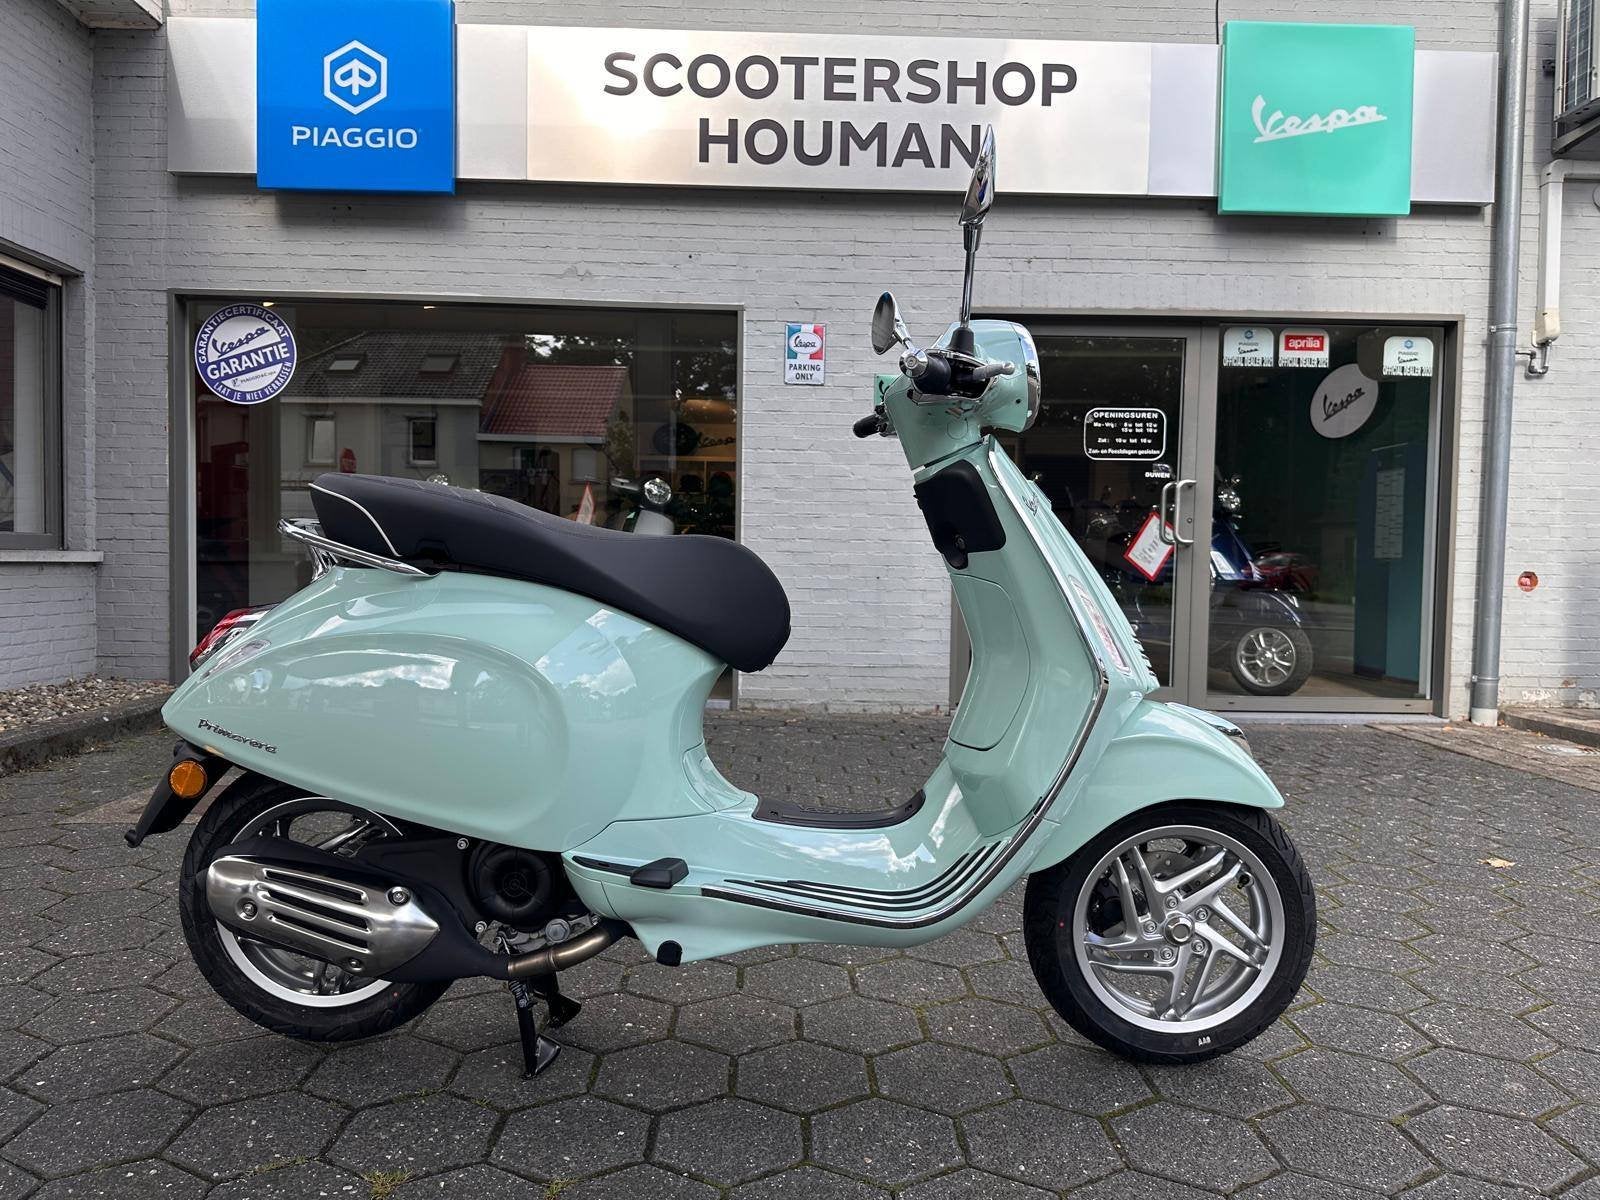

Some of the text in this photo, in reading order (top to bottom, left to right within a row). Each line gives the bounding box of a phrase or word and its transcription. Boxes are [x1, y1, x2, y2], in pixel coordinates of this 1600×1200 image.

[603, 51, 1077, 107] SCOOTERSHOP
[292, 125, 418, 149] PIAGGIO
[1252, 95, 1387, 143] Vespa
[699, 117, 981, 169] HOUMAN
[199, 306, 289, 364] GARANTIECERTIFICAAT
[211, 326, 271, 358] Vespa
[793, 335, 816, 349] Vespa
[1288, 337, 1320, 349] aprilia
[206, 343, 290, 380] GARANTIE
[789, 363, 821, 372] PARKING
[213, 361, 293, 401] LAAT JE NIET VERRASSEN
[1323, 387, 1365, 422] Vespa
[198, 718, 277, 754] Primavera
